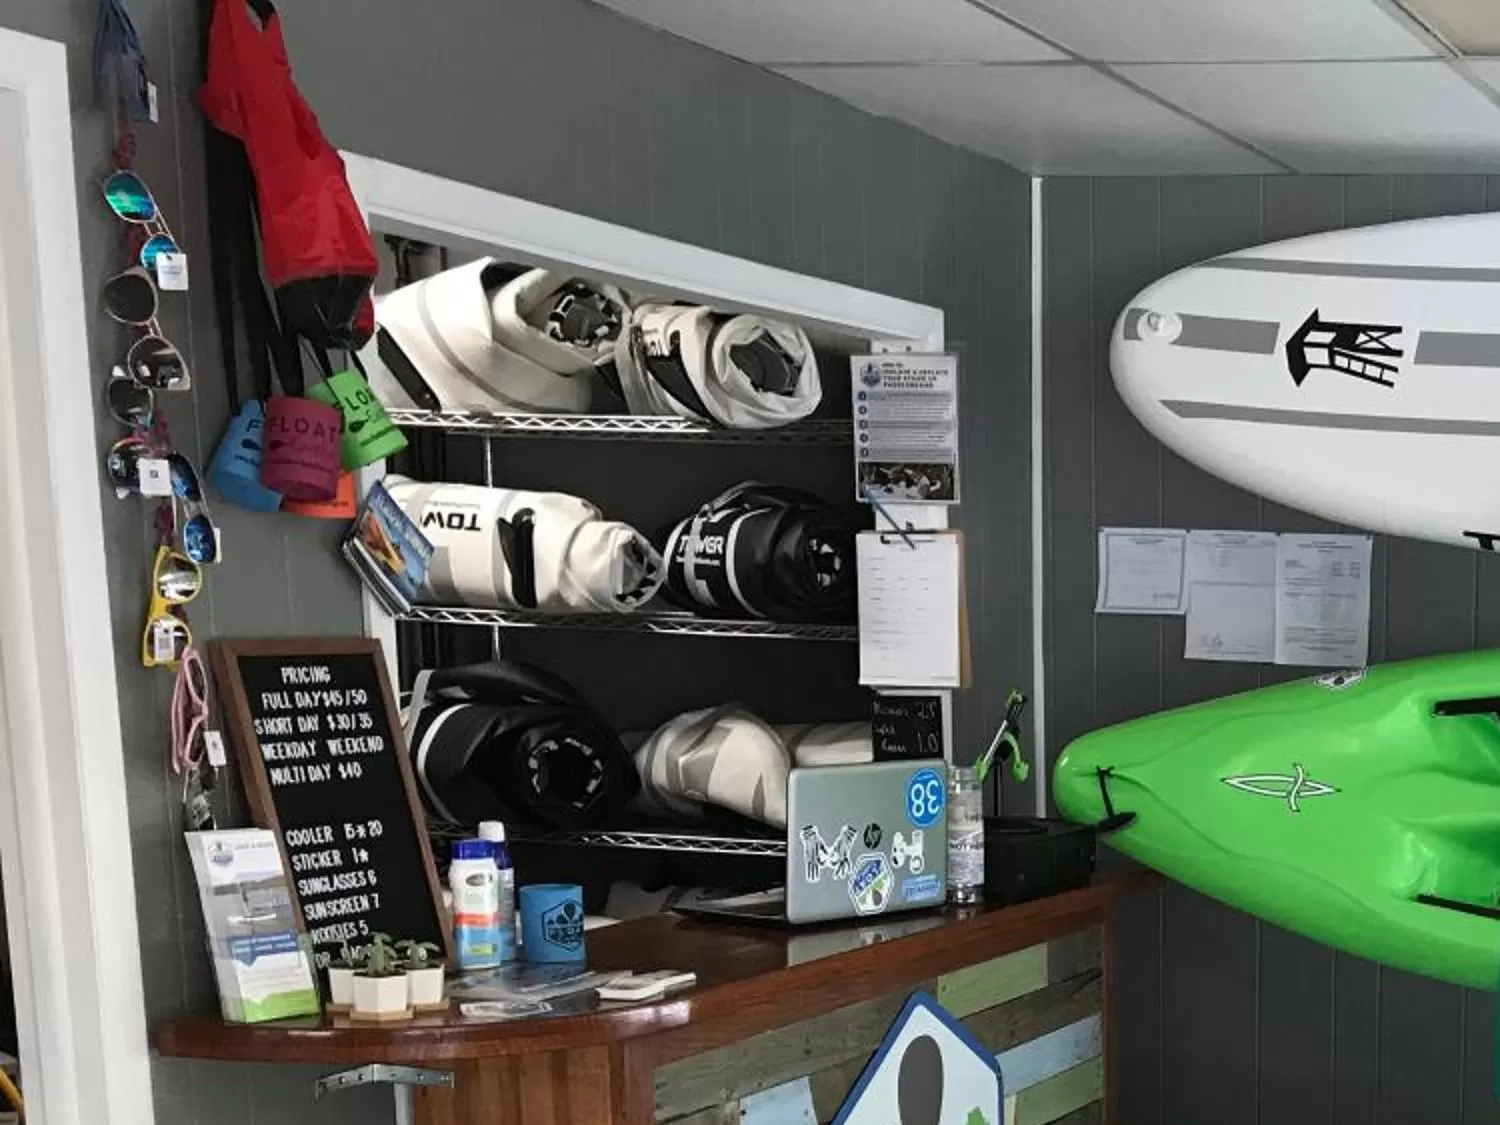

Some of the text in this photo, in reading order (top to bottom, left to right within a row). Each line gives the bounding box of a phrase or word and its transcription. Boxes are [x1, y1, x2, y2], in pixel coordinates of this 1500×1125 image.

[269, 415, 337, 442] FLOAT
[420, 510, 483, 532] TOW
[678, 535, 725, 555] TWER
[280, 665, 332, 685] PRICING
[261, 691, 294, 711] FULL
[294, 689, 321, 709] DAY
[254, 716, 294, 736] SHORT
[297, 713, 320, 733] DAY
[260, 735, 385, 762] WEEKDAY WEEKEND
[338, 760, 363, 780] $40
[285, 825, 335, 847] COOLER
[291, 848, 344, 873] STICKER
[297, 870, 367, 897] SUNGLASSES
[303, 893, 380, 922] SUNSCREEN 7
[359, 919, 369, 938] 5
